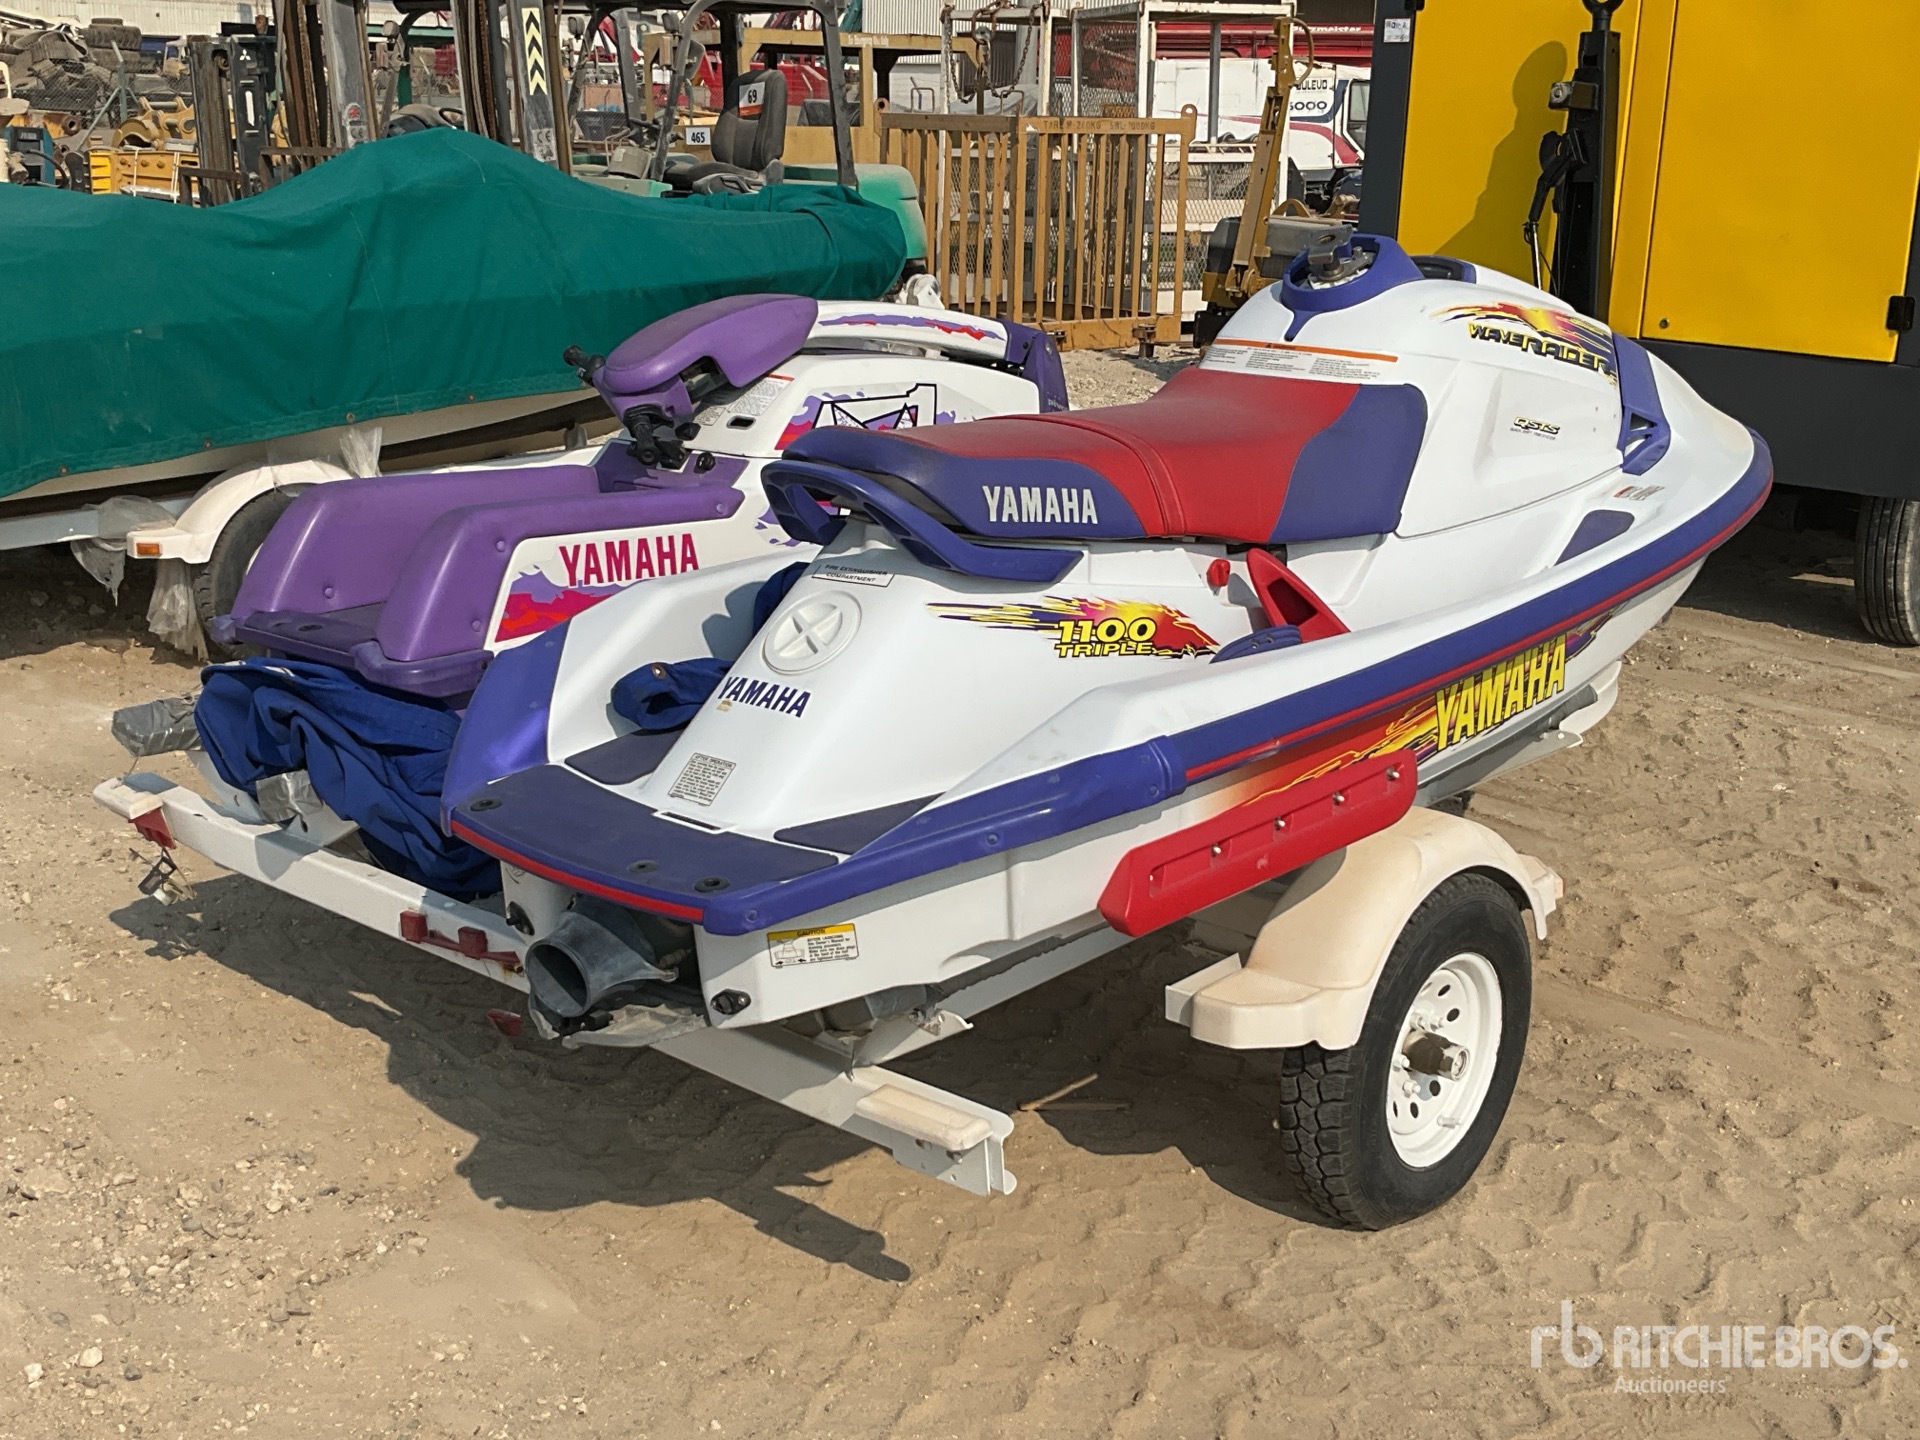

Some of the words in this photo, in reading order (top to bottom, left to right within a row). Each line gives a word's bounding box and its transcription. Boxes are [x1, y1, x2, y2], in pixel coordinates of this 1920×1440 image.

[747, 89, 758, 104] 69
[690, 131, 706, 143] 465
[1513, 416, 1561, 435] QSTS
[983, 485, 1099, 525] YAMAHA
[559, 533, 699, 587] YAMAHA
[825, 571, 876, 582] COMPARTMENT
[1058, 617, 1157, 643] 1100
[1055, 642, 1154, 658] TRIPLE
[717, 675, 812, 718] YAMAHA
[1435, 634, 1567, 751] YAMAHA
[796, 927, 826, 937] CAUTION
